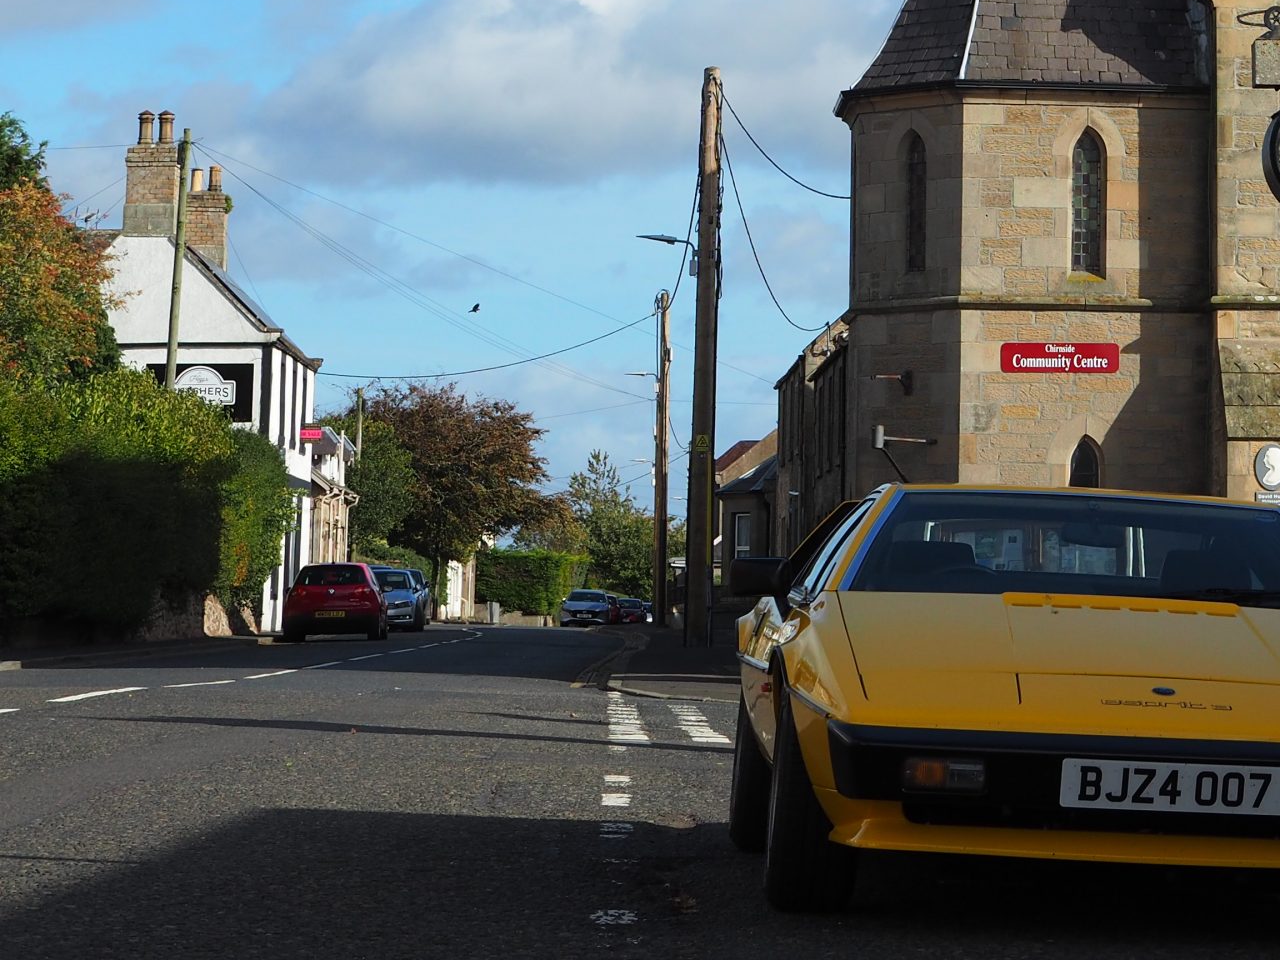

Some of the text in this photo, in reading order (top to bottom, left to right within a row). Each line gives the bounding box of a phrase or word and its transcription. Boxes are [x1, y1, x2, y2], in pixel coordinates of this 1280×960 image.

[1045, 344, 1075, 353] Chirnside
[1012, 353, 1108, 371] Community Centre
[1077, 765, 1273, 809] BJZ4 007
